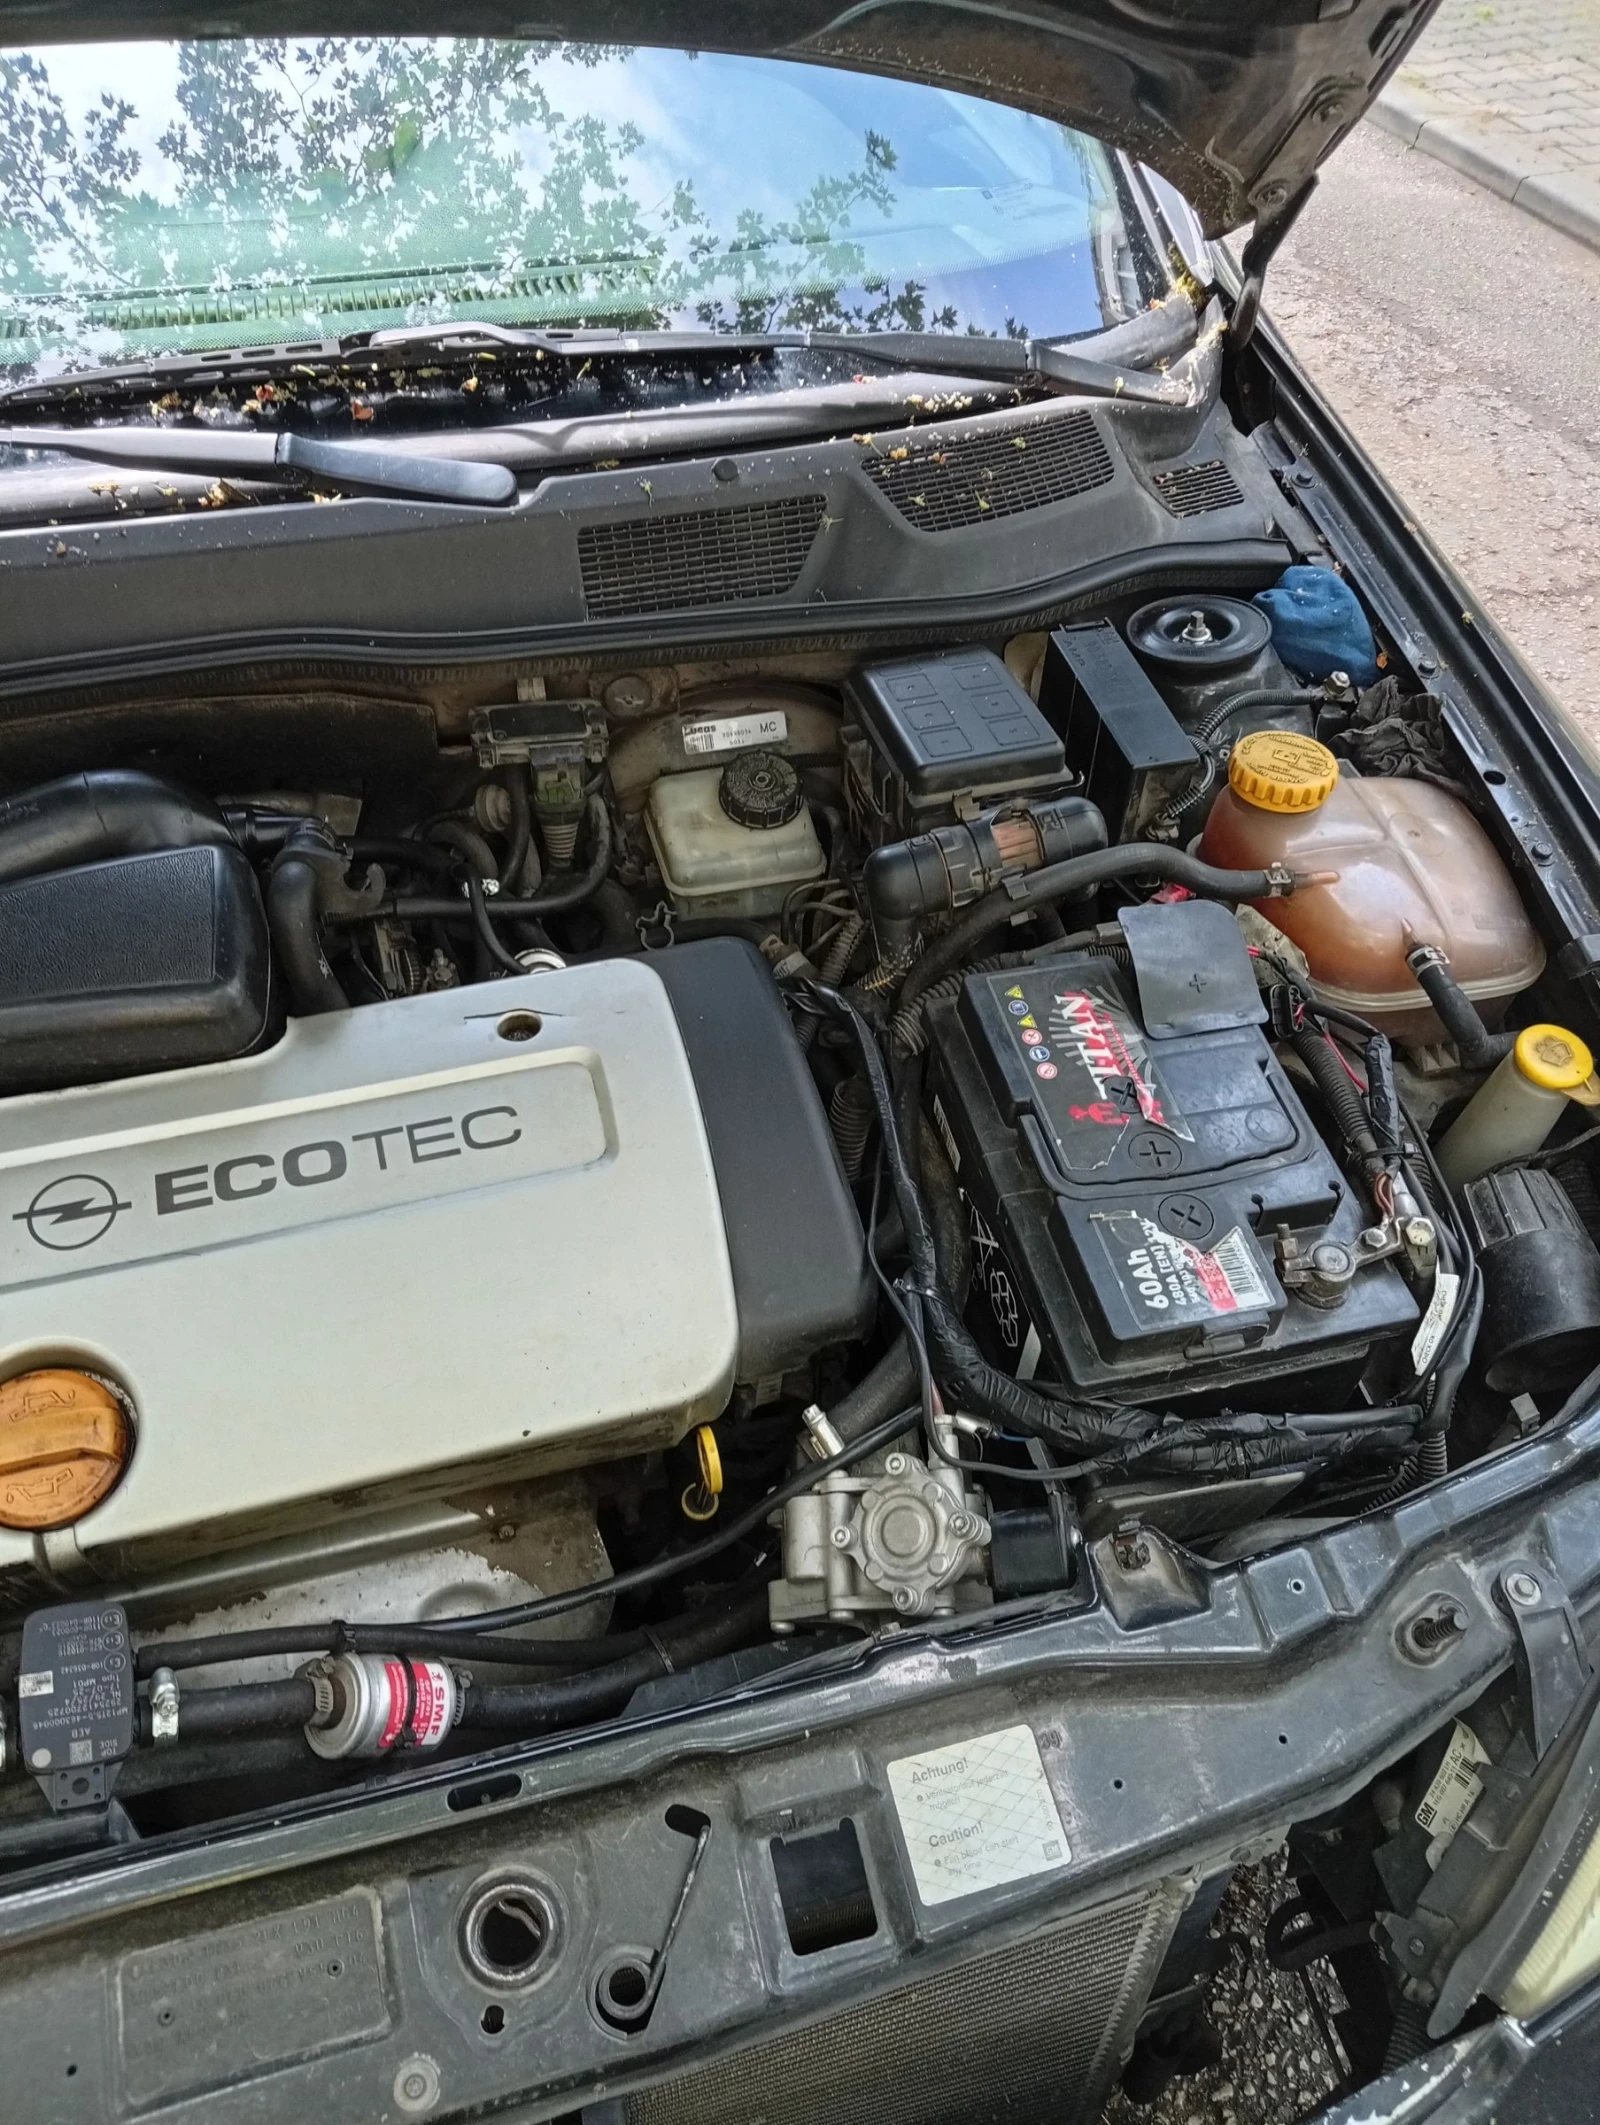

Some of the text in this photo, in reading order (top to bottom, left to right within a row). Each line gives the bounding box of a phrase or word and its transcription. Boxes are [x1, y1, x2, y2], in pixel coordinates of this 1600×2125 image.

[684, 724, 717, 736] Lucas
[759, 721, 777, 734] MC
[154, 1105, 522, 1216] ECOTEC
[1150, 1245, 1174, 1273] [EN]
[1126, 1248, 1170, 1309] 60Ah
[1165, 1274, 1187, 1305] 480A
[431, 1687, 444, 1736] SMF
[911, 1757, 969, 1784] Achtung!
[1450, 1747, 1462, 1766] AC
[1416, 1802, 1435, 1826] GM
[928, 1820, 984, 1848] Caution!
